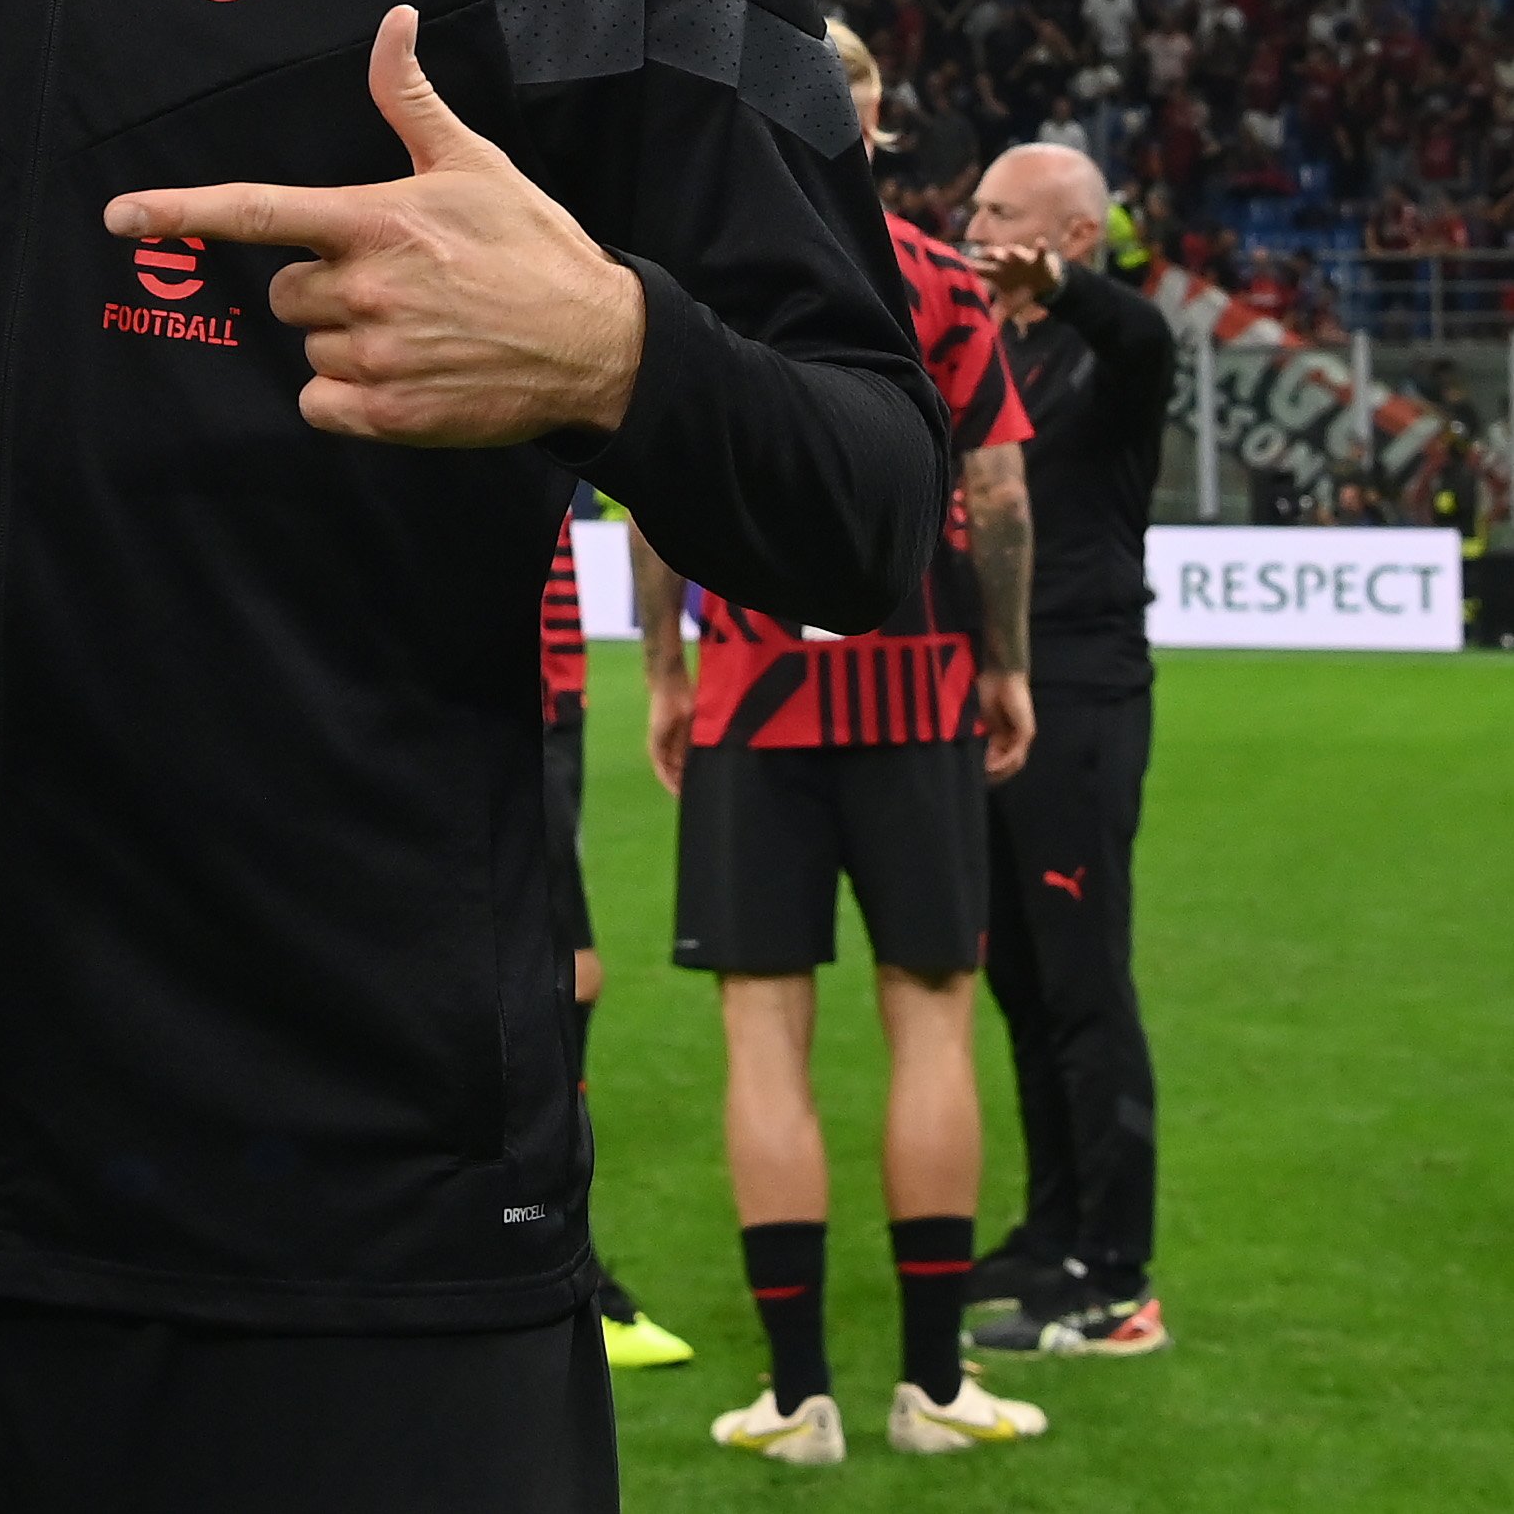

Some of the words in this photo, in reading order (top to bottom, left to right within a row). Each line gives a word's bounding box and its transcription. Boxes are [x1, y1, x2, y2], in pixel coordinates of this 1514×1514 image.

[102, 302, 240, 347] FOOTBALL
[1182, 563, 1443, 614] RESPECT
[503, 1203, 546, 1224] DRYCELL
